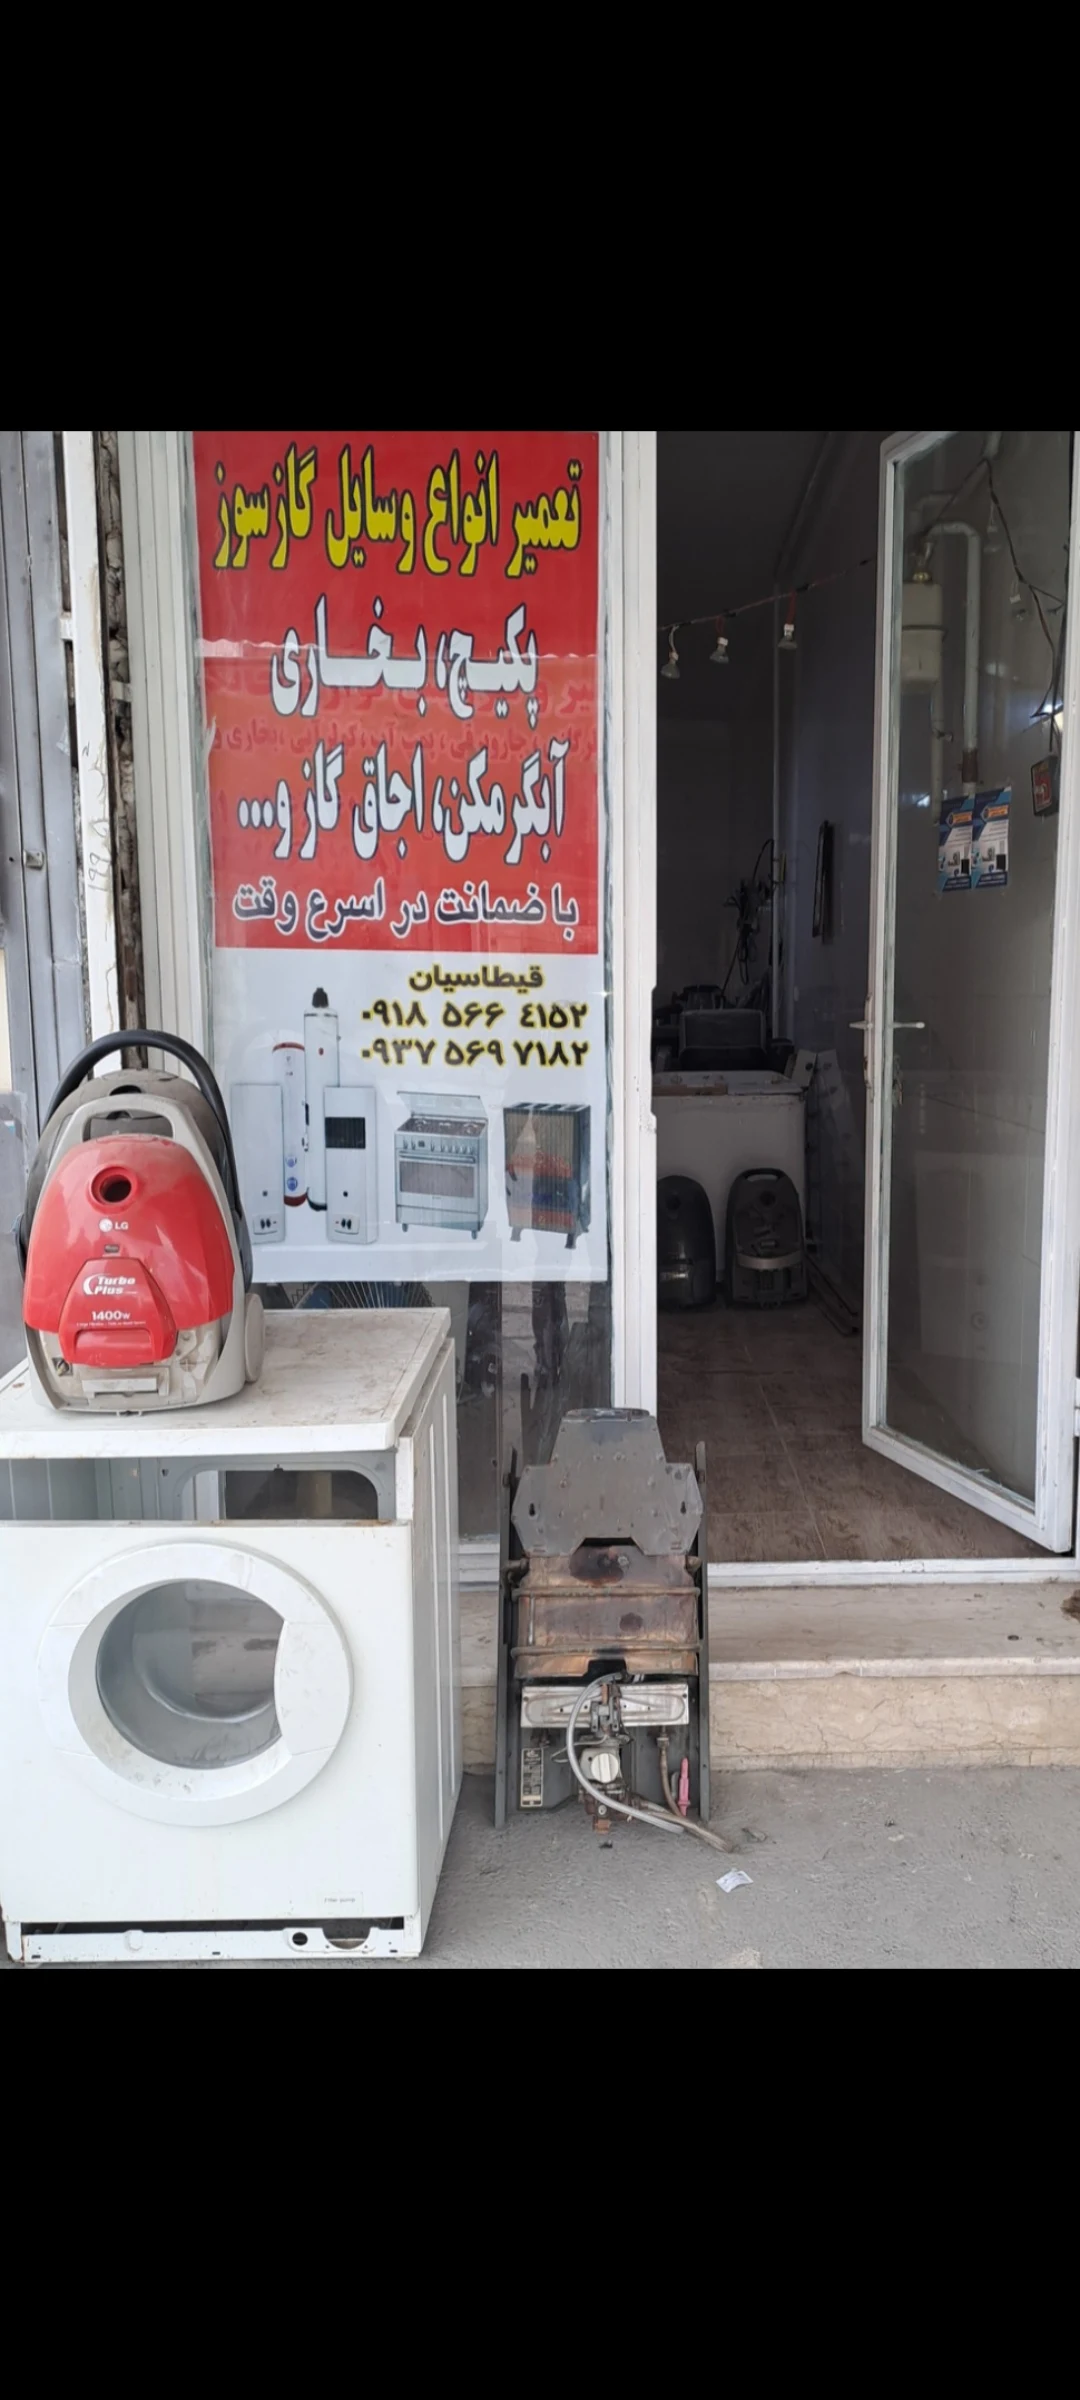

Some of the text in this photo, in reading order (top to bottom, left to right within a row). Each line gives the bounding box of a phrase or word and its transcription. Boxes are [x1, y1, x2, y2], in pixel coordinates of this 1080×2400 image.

[325, 445, 416, 573] وسایل
[423, 449, 499, 577] انواع
[505, 459, 583, 578] تعمیر
[270, 593, 428, 717] بخاری
[299, 740, 345, 861] گاز
[352, 739, 424, 861] اجاق
[233, 876, 580, 941] با ضمانت در اسرع وقت
[409, 965, 543, 994] قیطاسیان
[94, 1285, 124, 1295] Plus
[98, 1275, 136, 1285] Turbo
